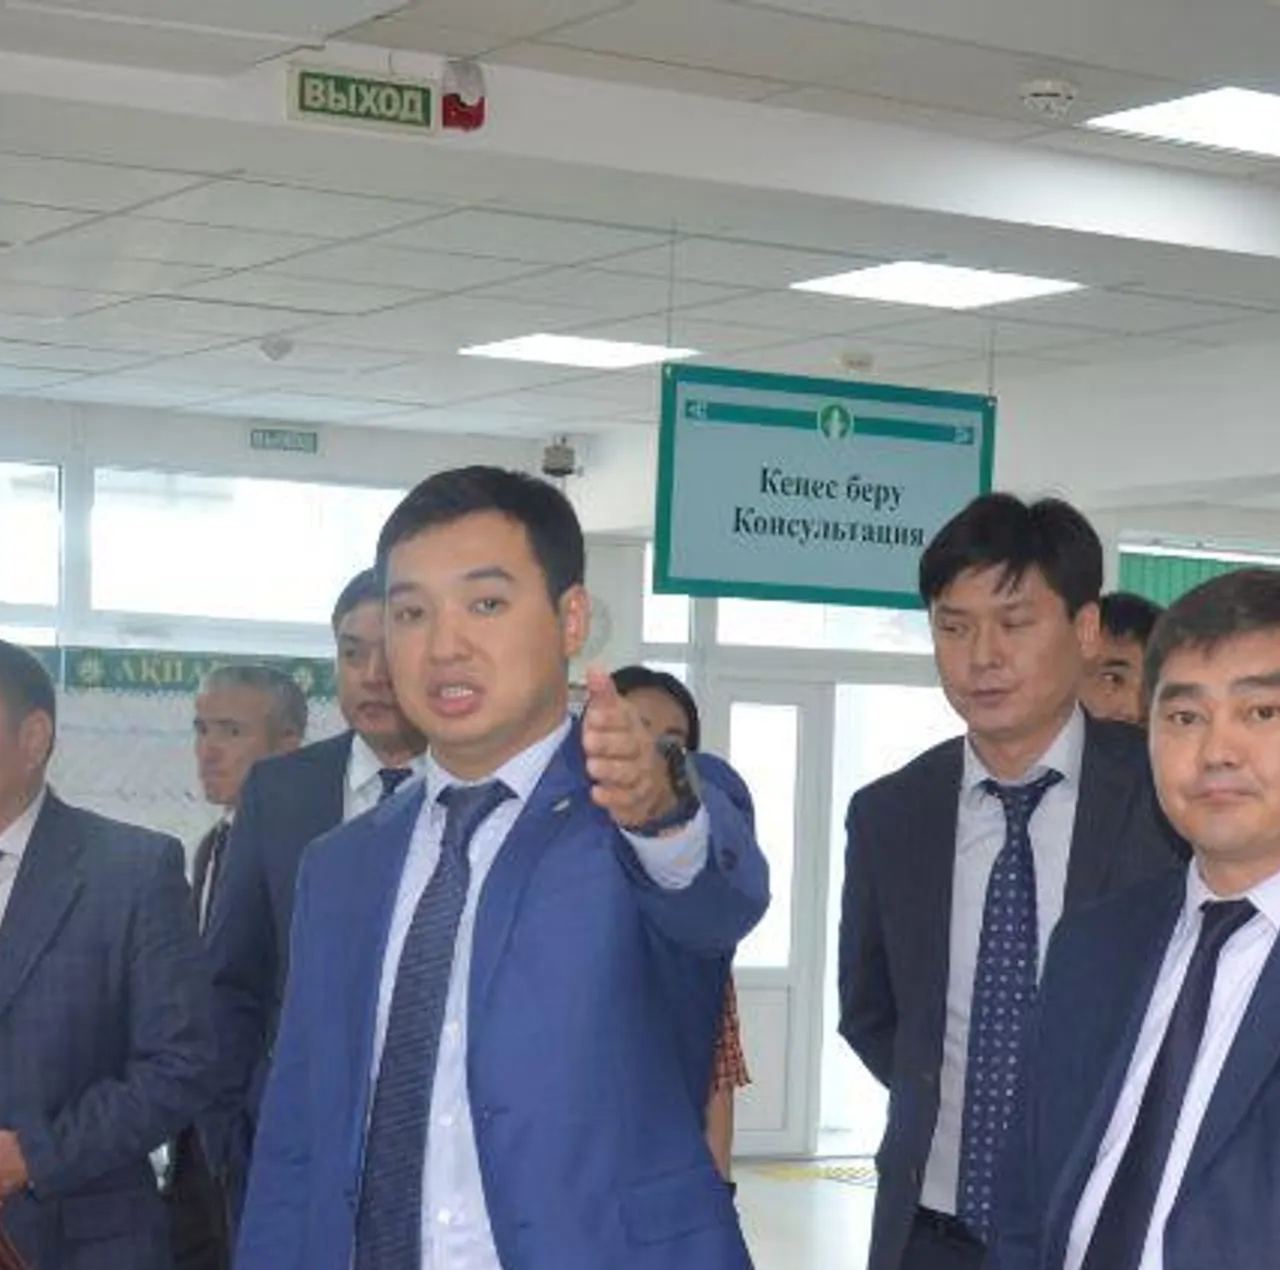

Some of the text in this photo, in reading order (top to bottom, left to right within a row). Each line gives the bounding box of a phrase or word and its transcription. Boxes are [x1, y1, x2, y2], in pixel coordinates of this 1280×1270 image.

[303, 76, 425, 124] ВЫХОД
[846, 475, 906, 511] беру
[732, 505, 925, 547] Консультация
